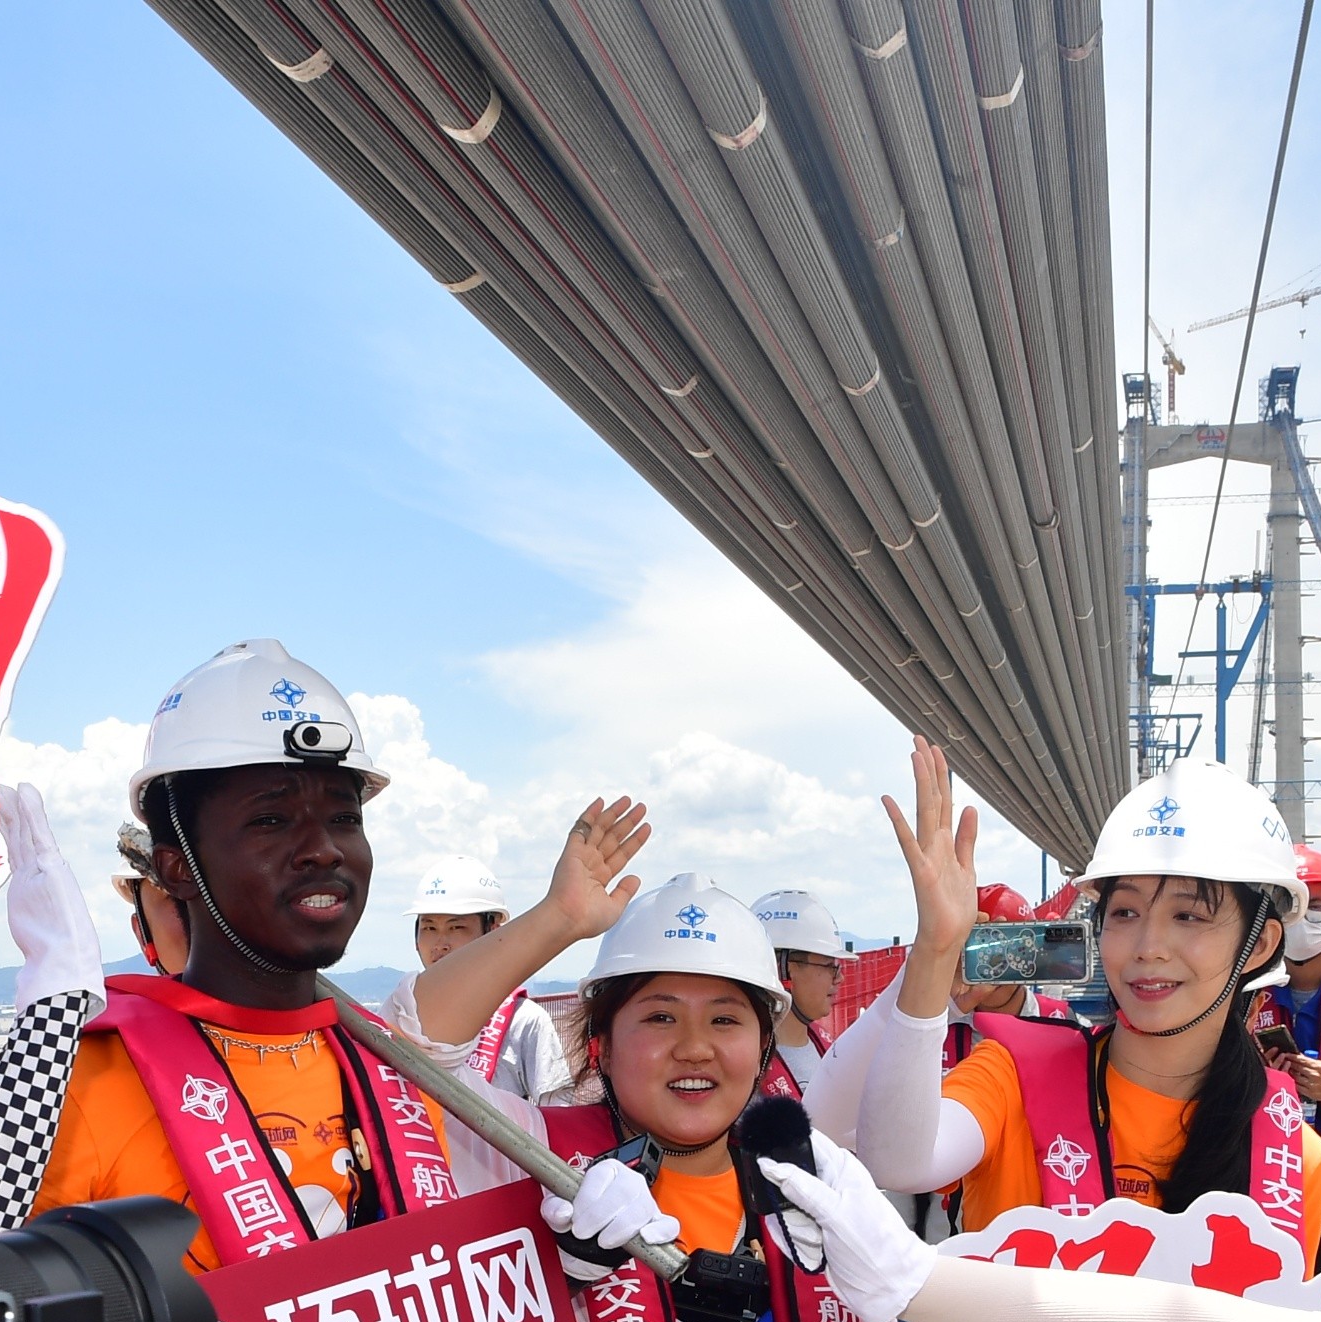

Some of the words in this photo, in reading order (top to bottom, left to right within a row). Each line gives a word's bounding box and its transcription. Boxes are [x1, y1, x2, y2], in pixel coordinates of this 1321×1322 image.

[1133, 825, 1186, 838] 中国交建
[664, 928, 717, 943] 中国交建
